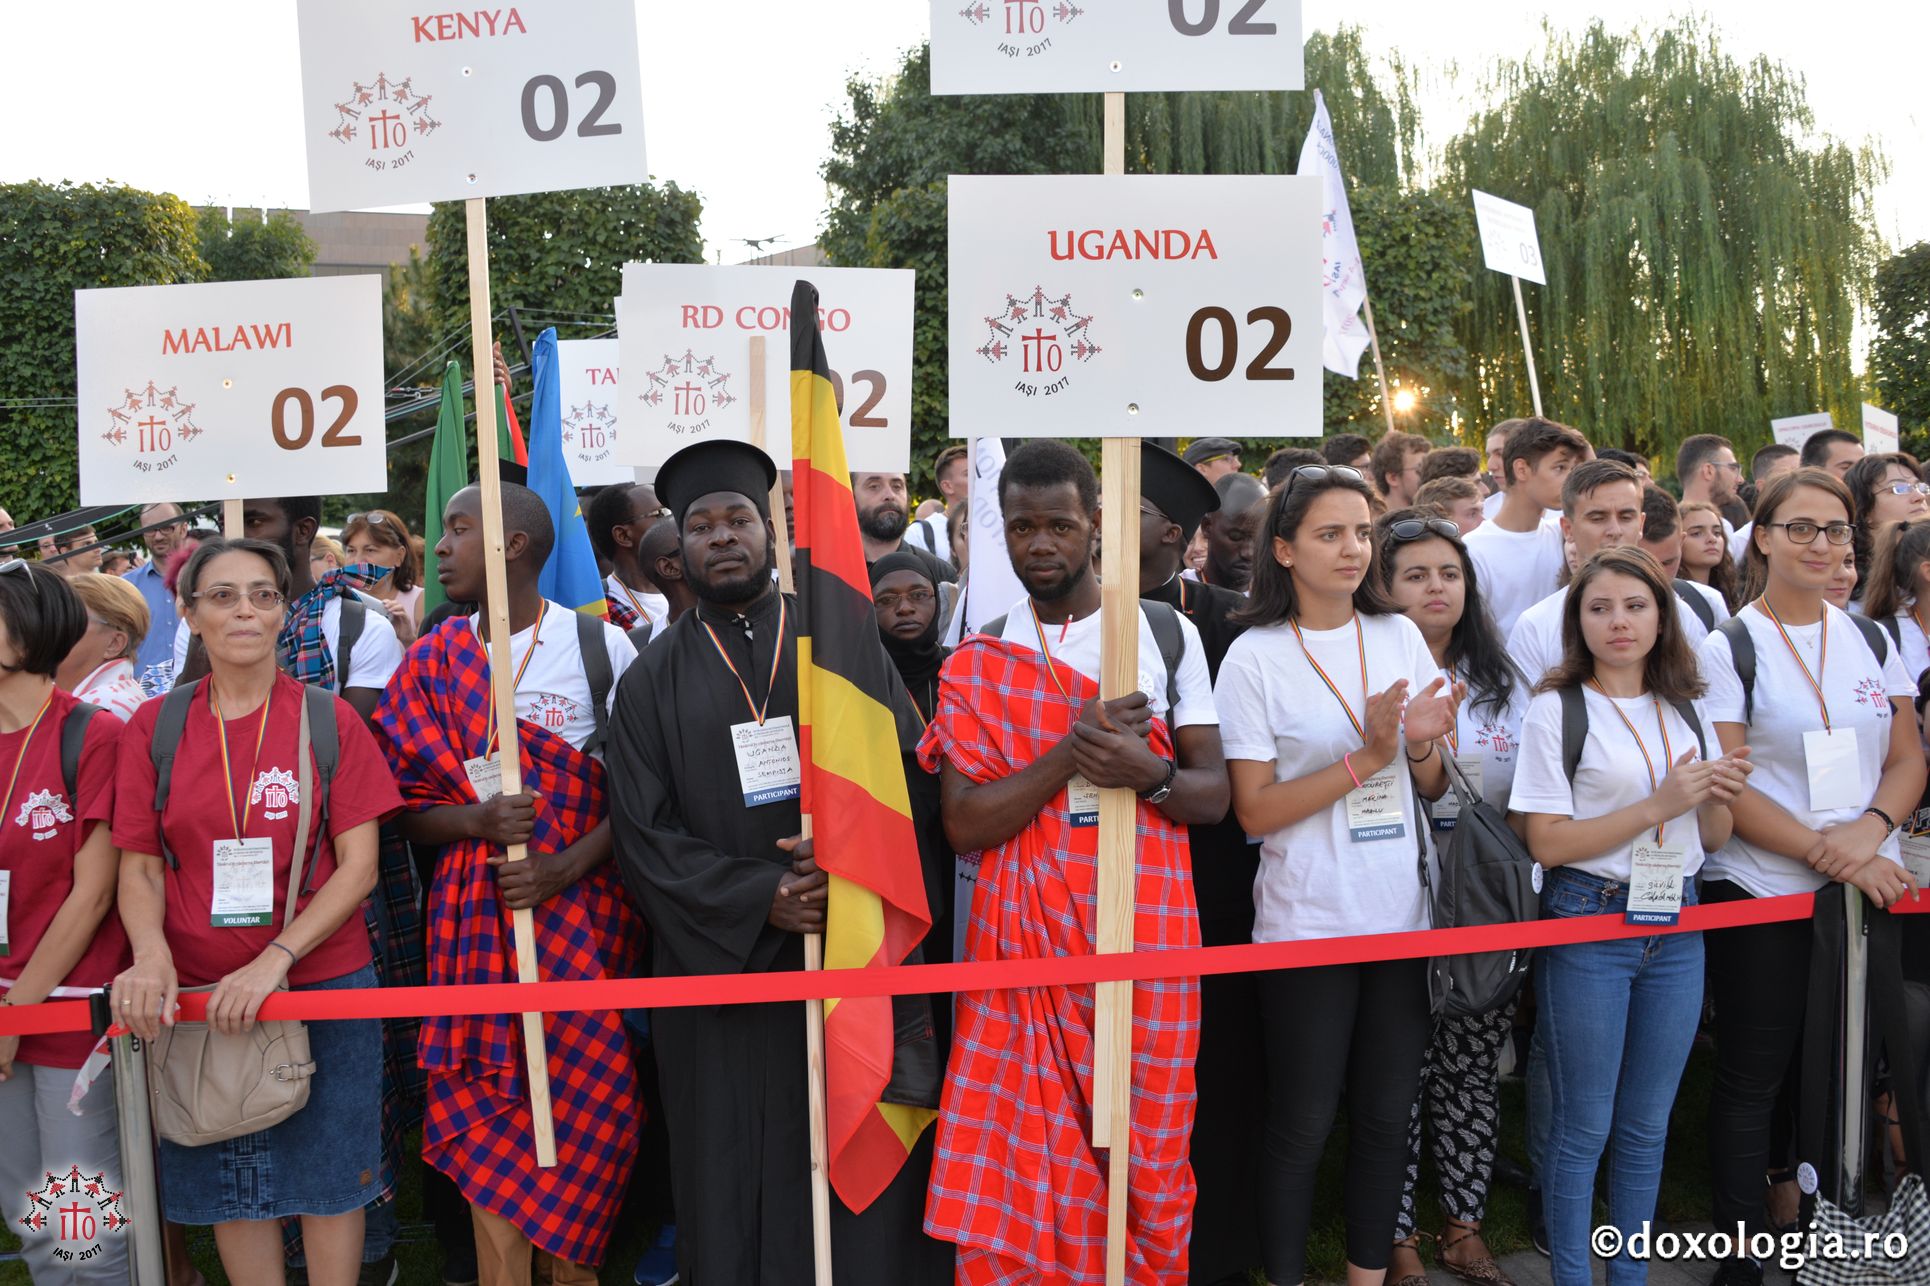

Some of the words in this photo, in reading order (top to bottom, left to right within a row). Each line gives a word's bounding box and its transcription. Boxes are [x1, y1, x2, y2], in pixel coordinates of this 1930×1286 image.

[411, 7, 527, 43] KENYA
[1027, 37, 1053, 57] 2017
[520, 70, 622, 142] 02
[391, 150, 415, 169] 2017
[1048, 229, 1218, 261] UGANDA
[1519, 242, 1538, 267] 03
[681, 304, 724, 329] RD
[162, 322, 292, 354] MALAWI
[1186, 306, 1295, 382] 02
[585, 368, 620, 385] TA
[1044, 376, 1070, 396] 2017
[271, 384, 362, 451] 02
[690, 418, 712, 434] 2017
[157, 454, 178, 472] 2017
[595, 449, 611, 462] 2017
[753, 787, 797, 802] PARTICIPANT
[1358, 828, 1397, 838] PARTICIPANT
[223, 916, 260, 925] VOLUNTAR
[1633, 914, 1672, 922] PARTICIPANT
